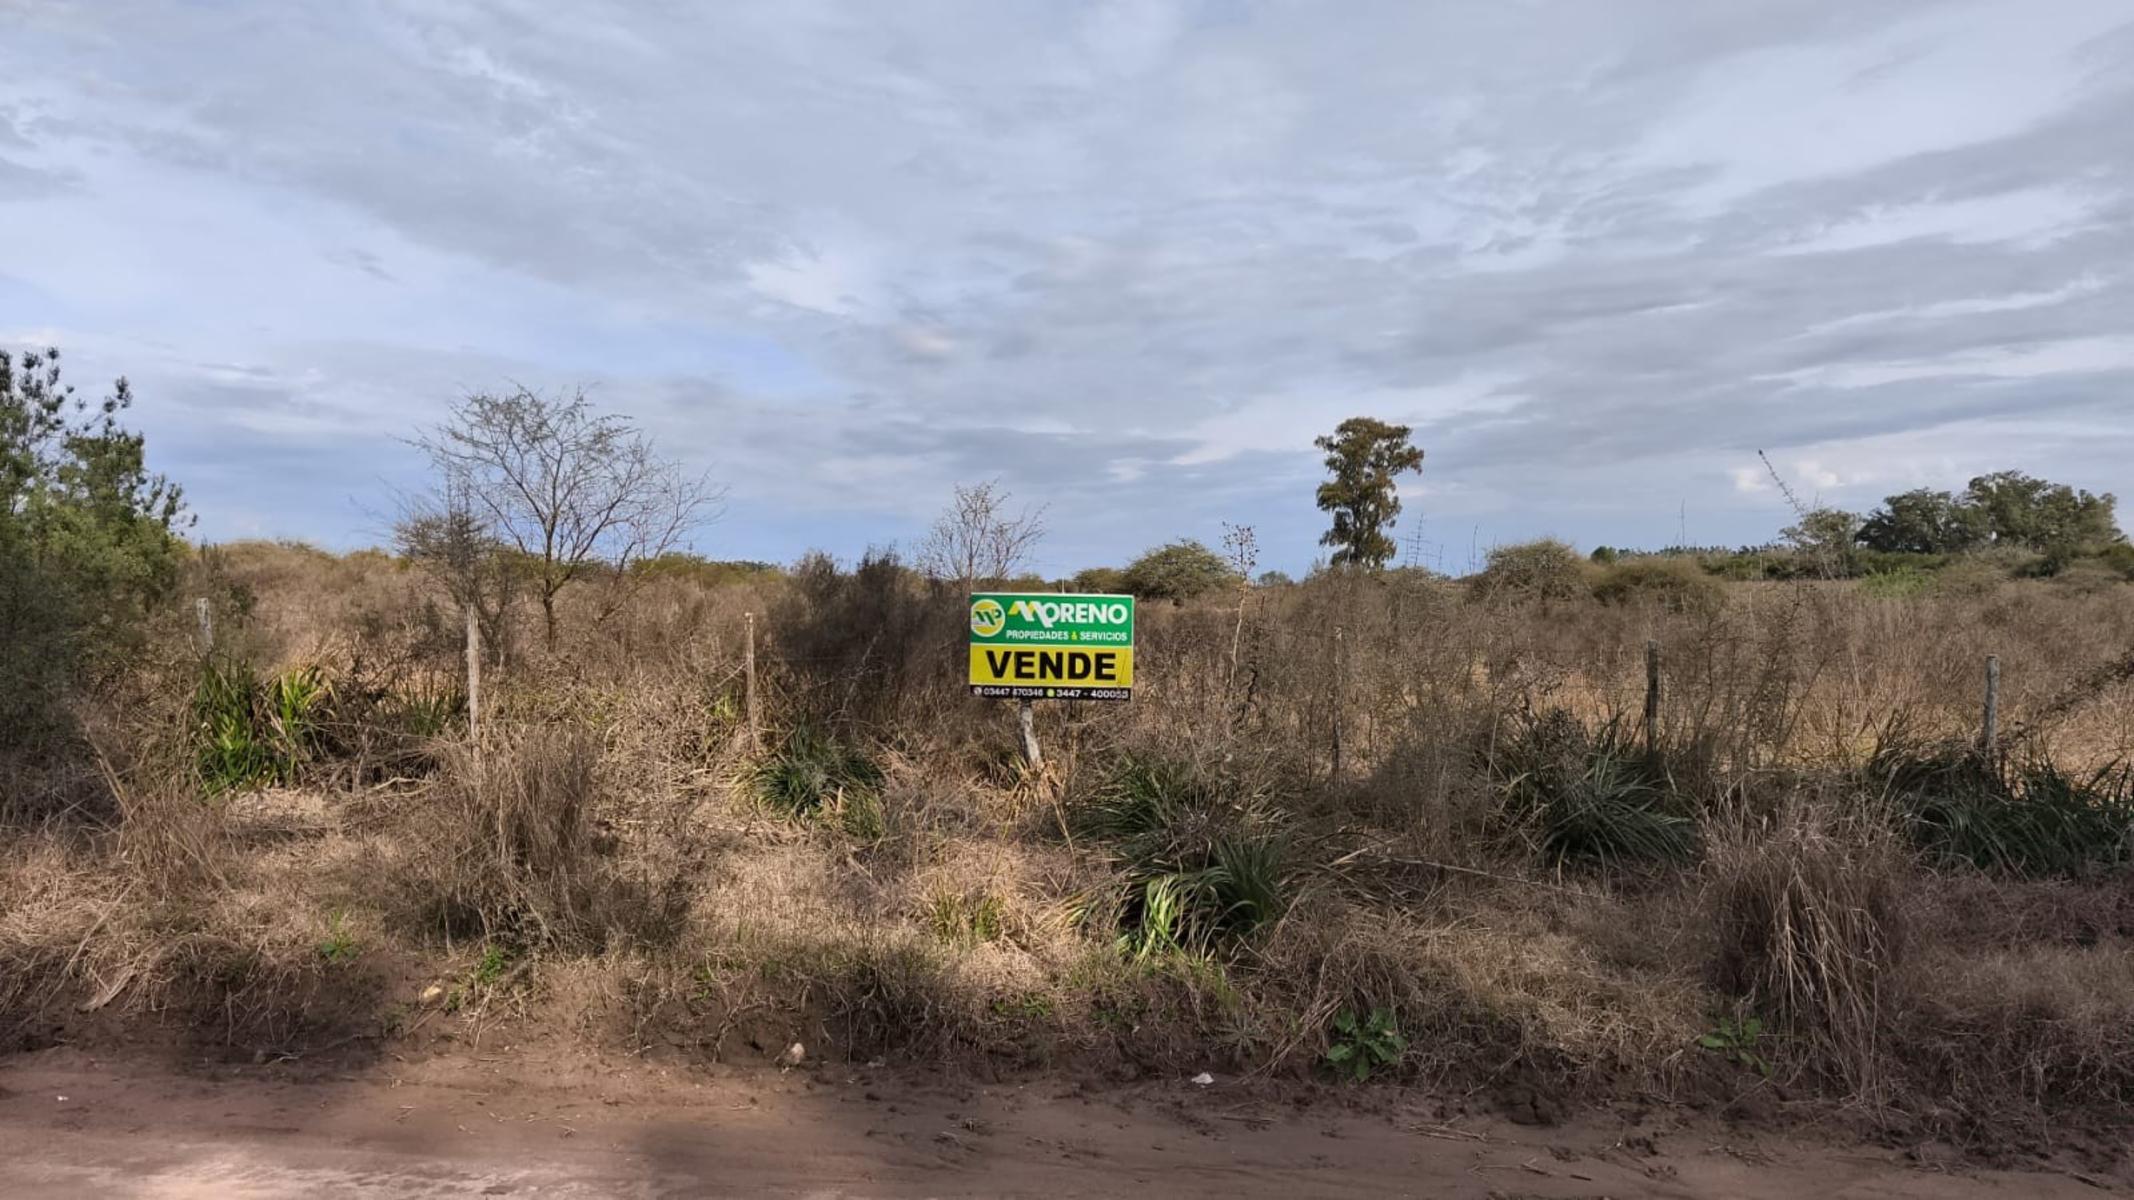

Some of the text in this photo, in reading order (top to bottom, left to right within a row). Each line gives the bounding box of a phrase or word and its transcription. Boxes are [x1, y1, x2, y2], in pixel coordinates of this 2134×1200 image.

[1008, 600, 1128, 628] MORENO
[1006, 630, 1128, 641] PROPIEDADES & SERVICIOS
[986, 650, 1116, 680] VENDE
[1056, 688, 1081, 697] 3447
